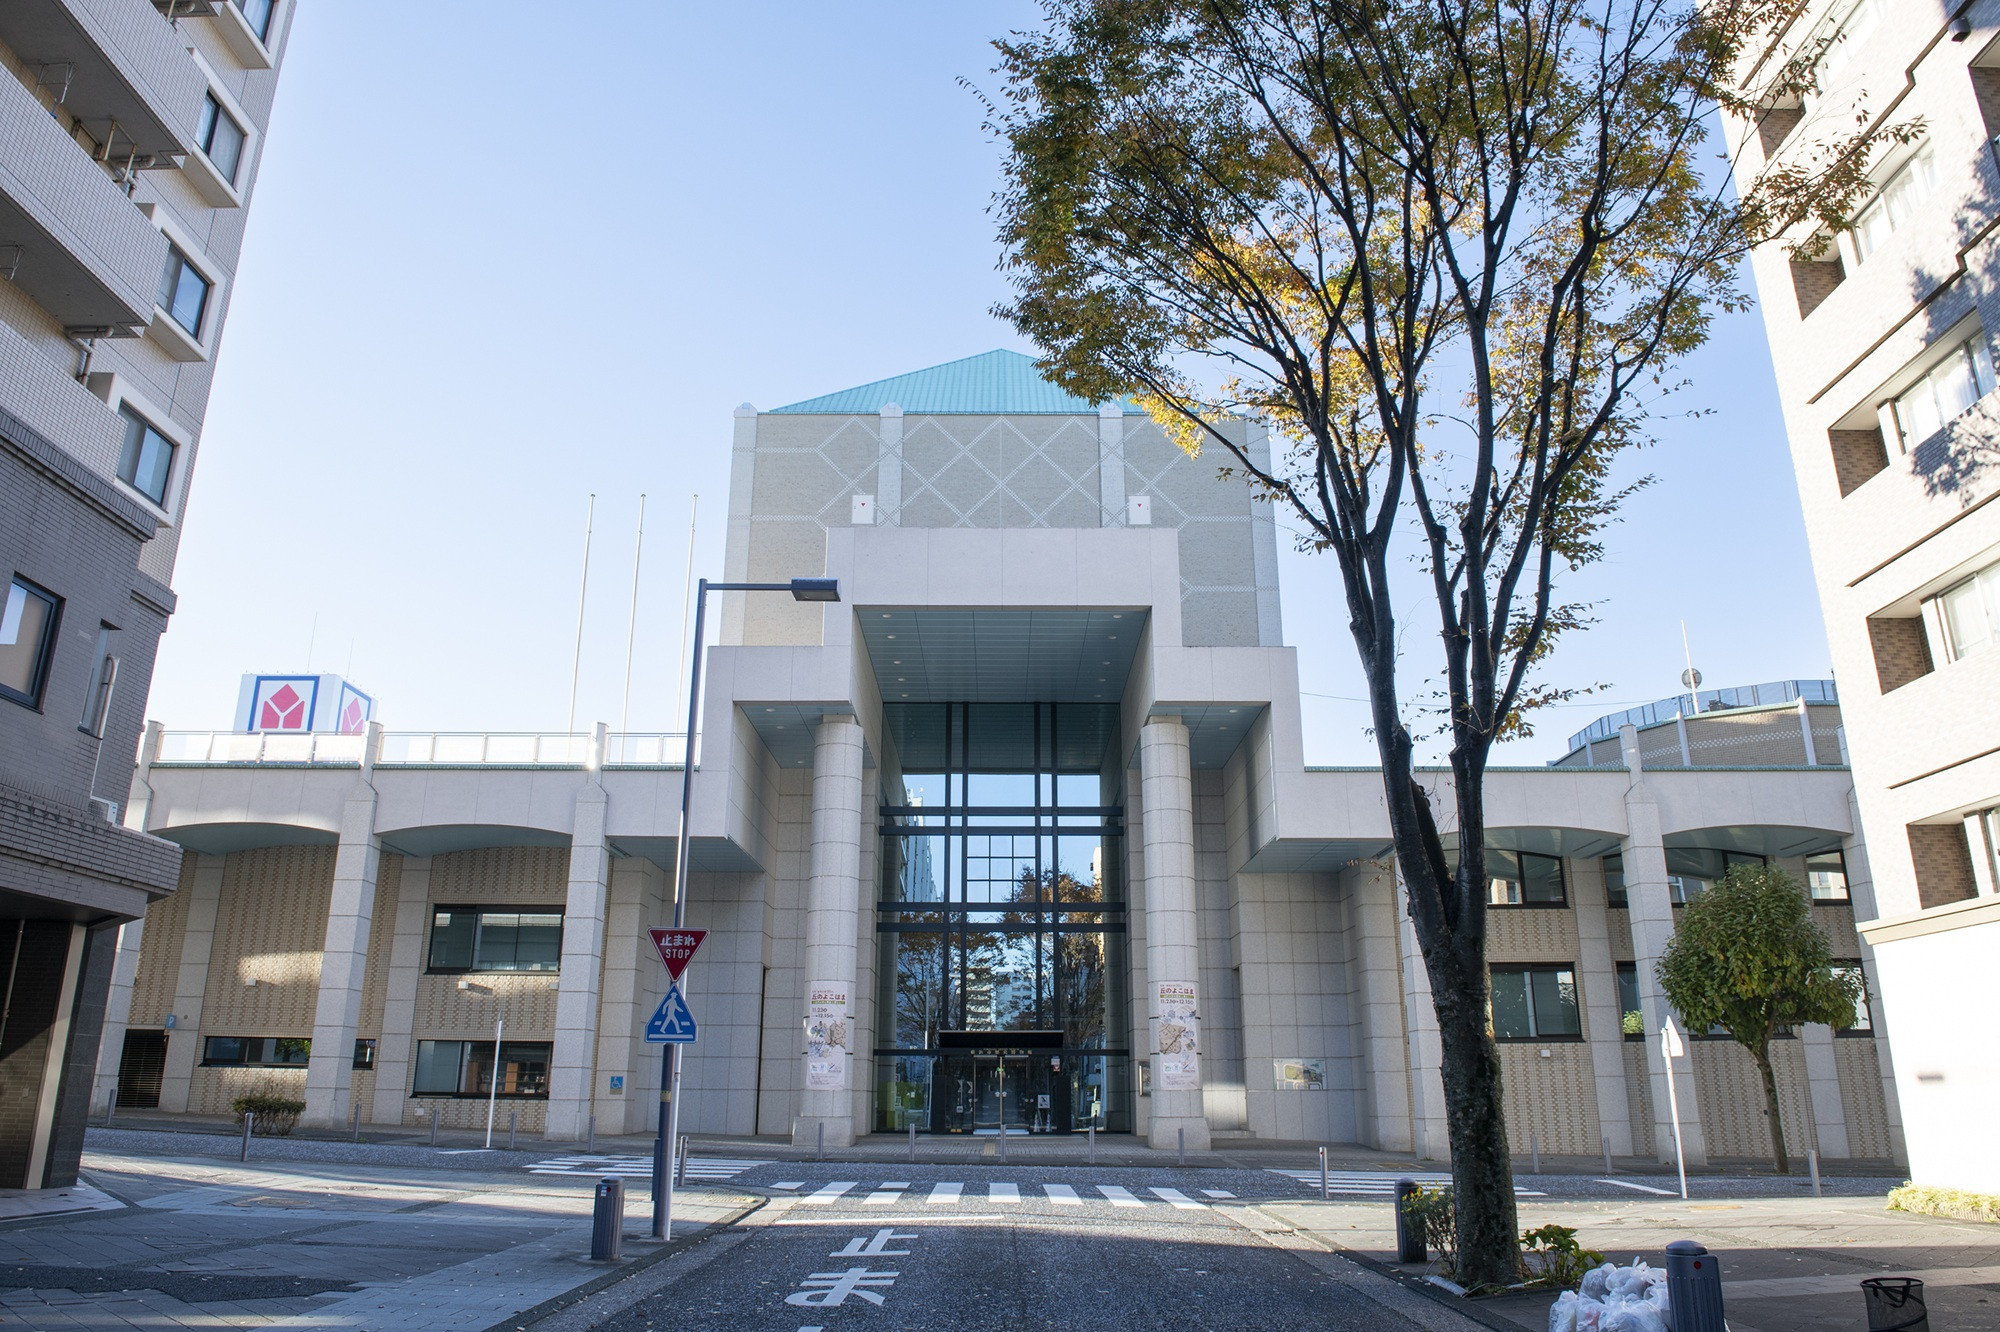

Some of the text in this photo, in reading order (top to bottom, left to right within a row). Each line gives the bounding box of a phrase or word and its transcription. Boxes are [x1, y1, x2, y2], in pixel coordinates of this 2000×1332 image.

[660, 934, 696, 946] 止まれ
[665, 948, 690, 959] STOP
[168, 1016, 175, 1027] P
[784, 1228, 919, 1332] 止ま
